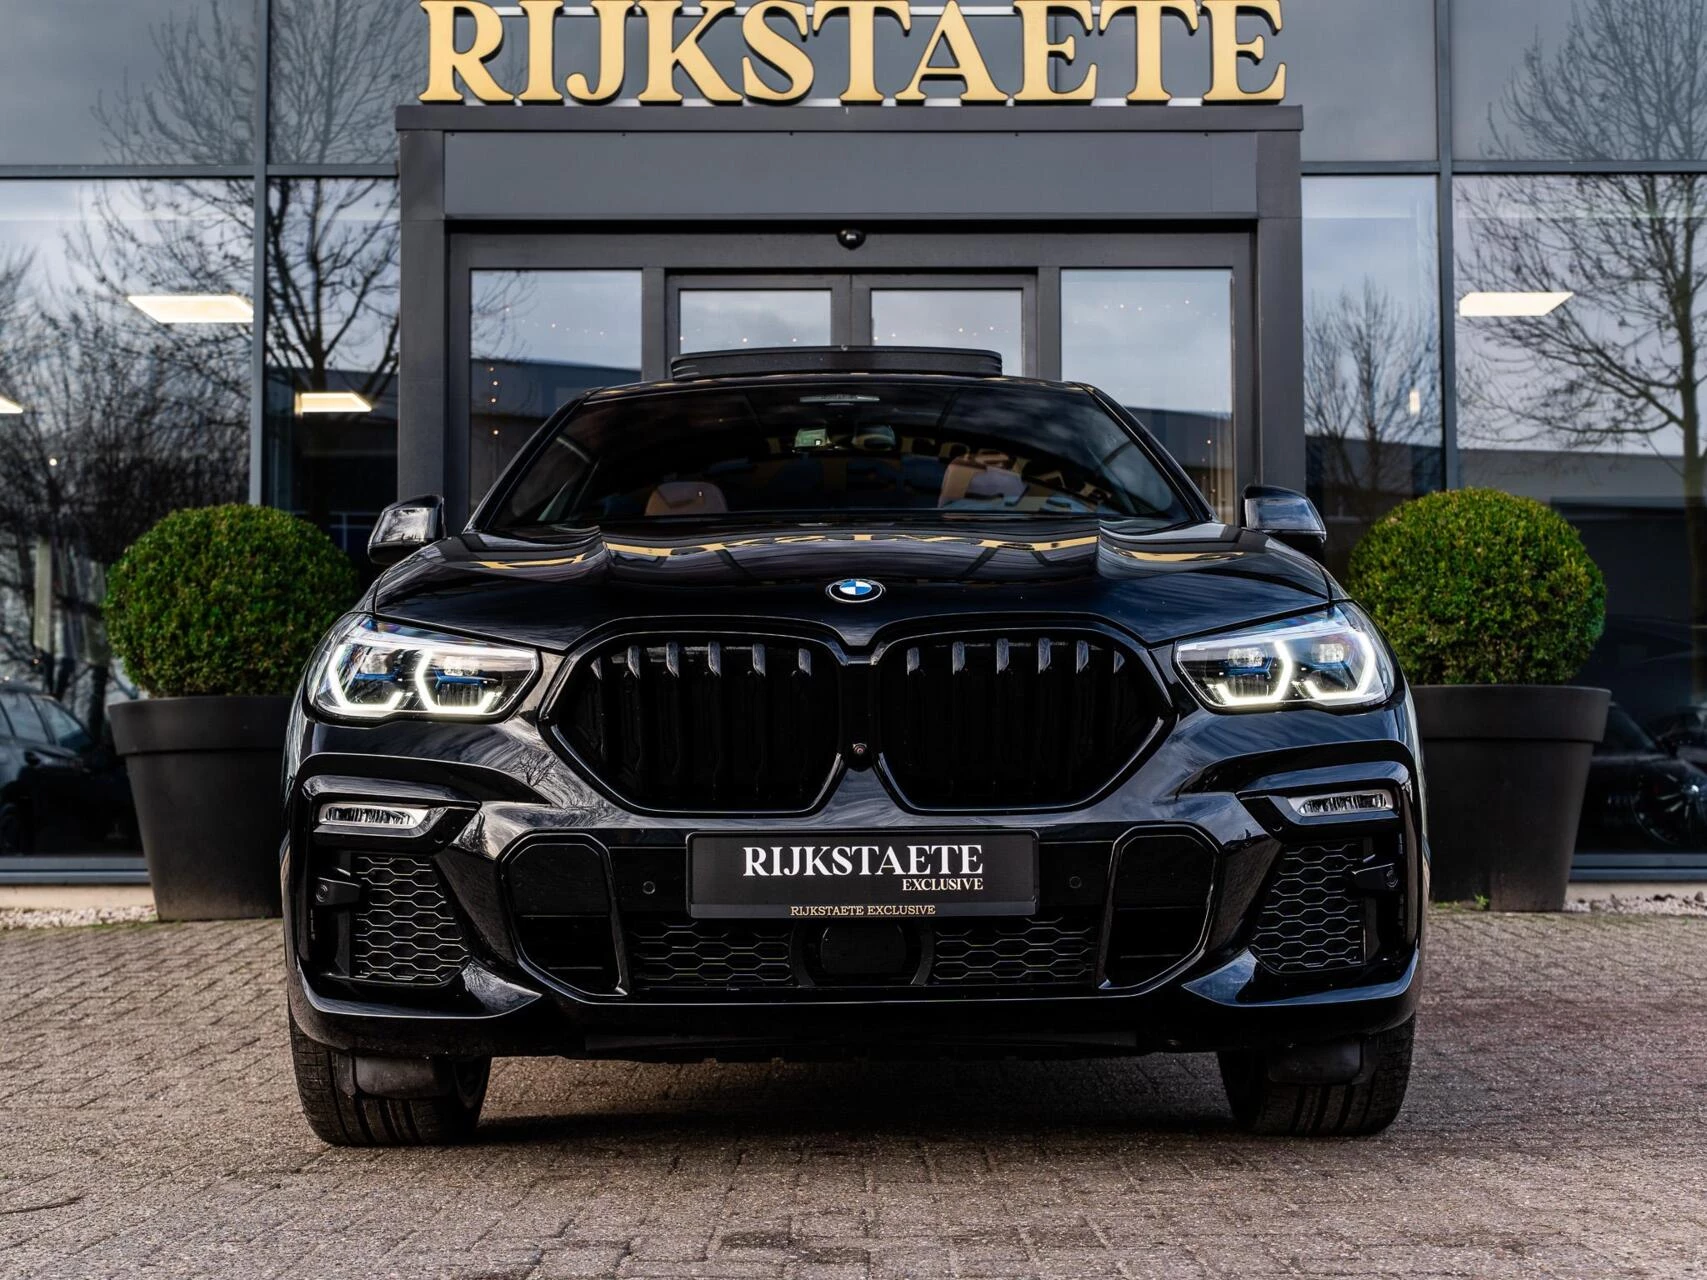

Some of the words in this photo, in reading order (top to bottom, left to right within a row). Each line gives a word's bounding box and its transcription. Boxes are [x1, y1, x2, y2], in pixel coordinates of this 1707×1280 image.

[418, 0, 1287, 105] RIJKSTAETE
[742, 844, 984, 877] RIJKSTAETE
[901, 877, 984, 892] EXCLUSIVE
[790, 904, 865, 917] RIJKSTAETE
[867, 904, 936, 916] EXCLUSIVE
